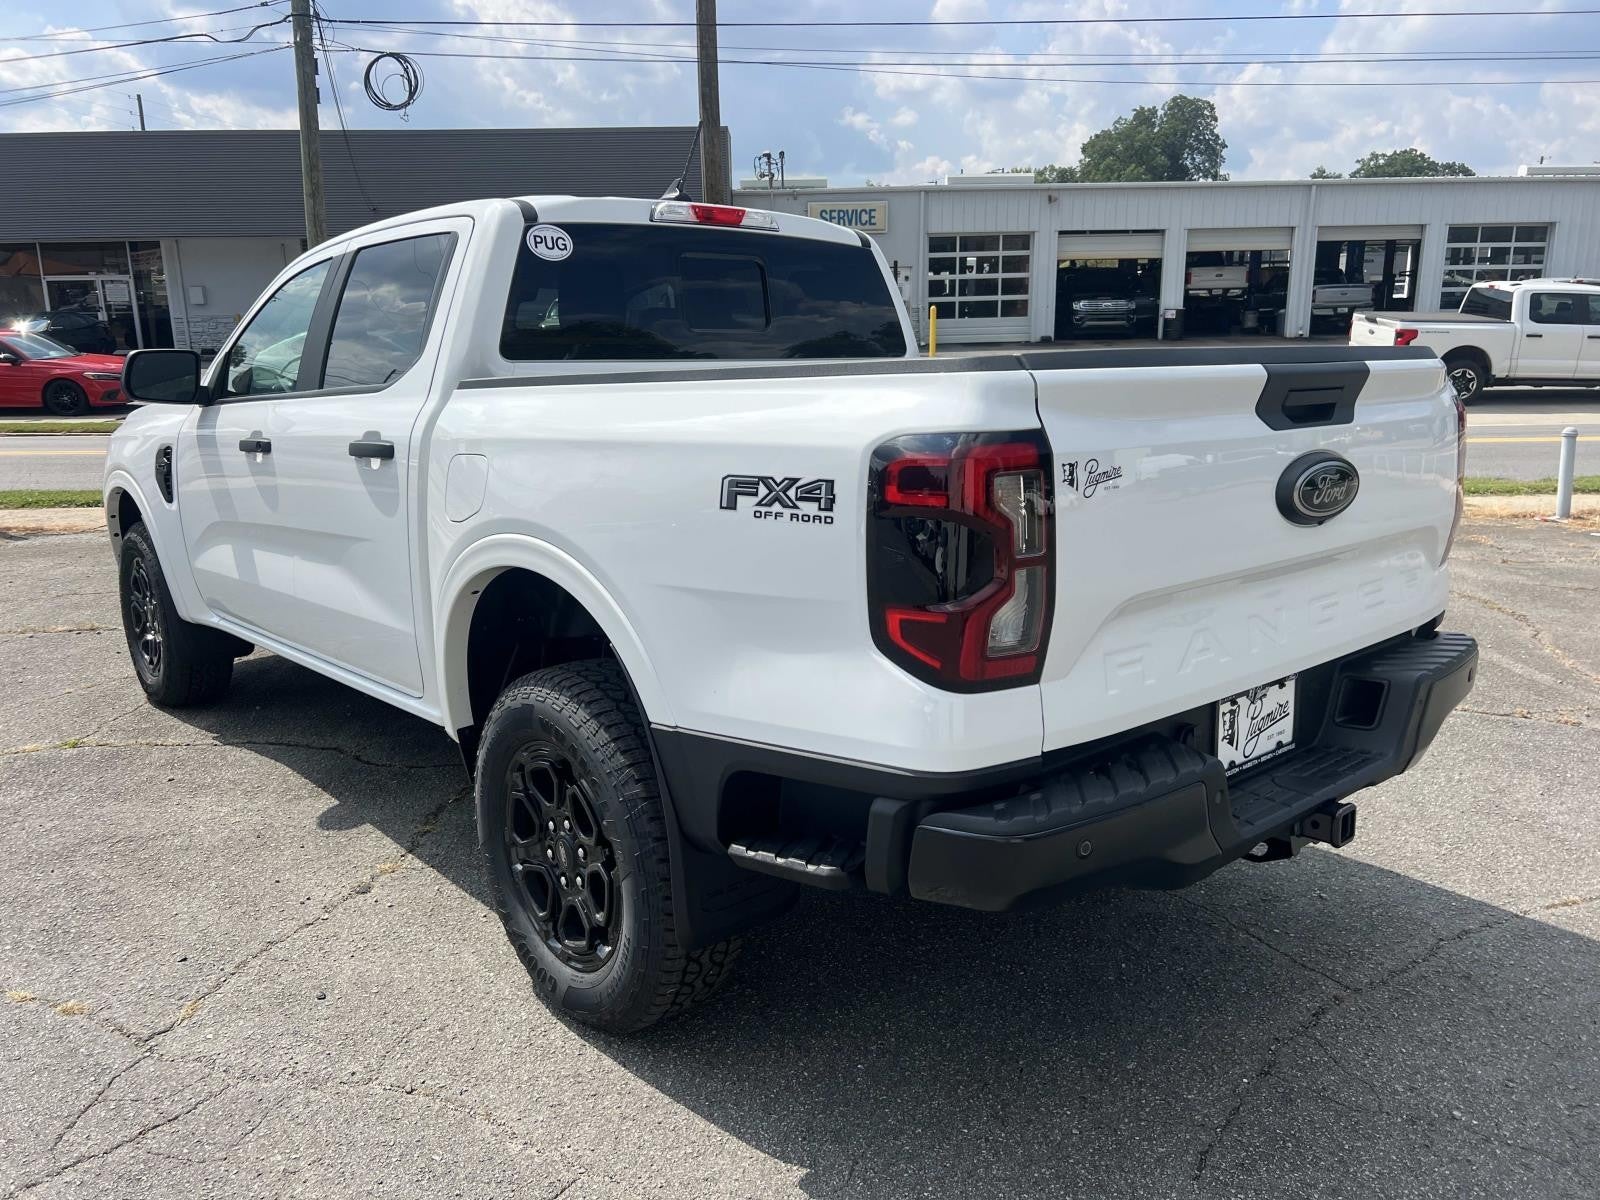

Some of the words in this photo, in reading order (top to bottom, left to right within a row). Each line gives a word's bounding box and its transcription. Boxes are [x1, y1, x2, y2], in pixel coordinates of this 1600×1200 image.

[820, 208, 877, 226] SERVICE
[533, 235, 567, 251] PUG
[720, 475, 835, 512] FX4
[1083, 459, 1122, 498] Pugmire
[1313, 473, 1348, 505] Ford
[753, 510, 784, 520] OFF
[790, 513, 834, 525] ROAD
[1243, 698, 1290, 758] Pugmire
